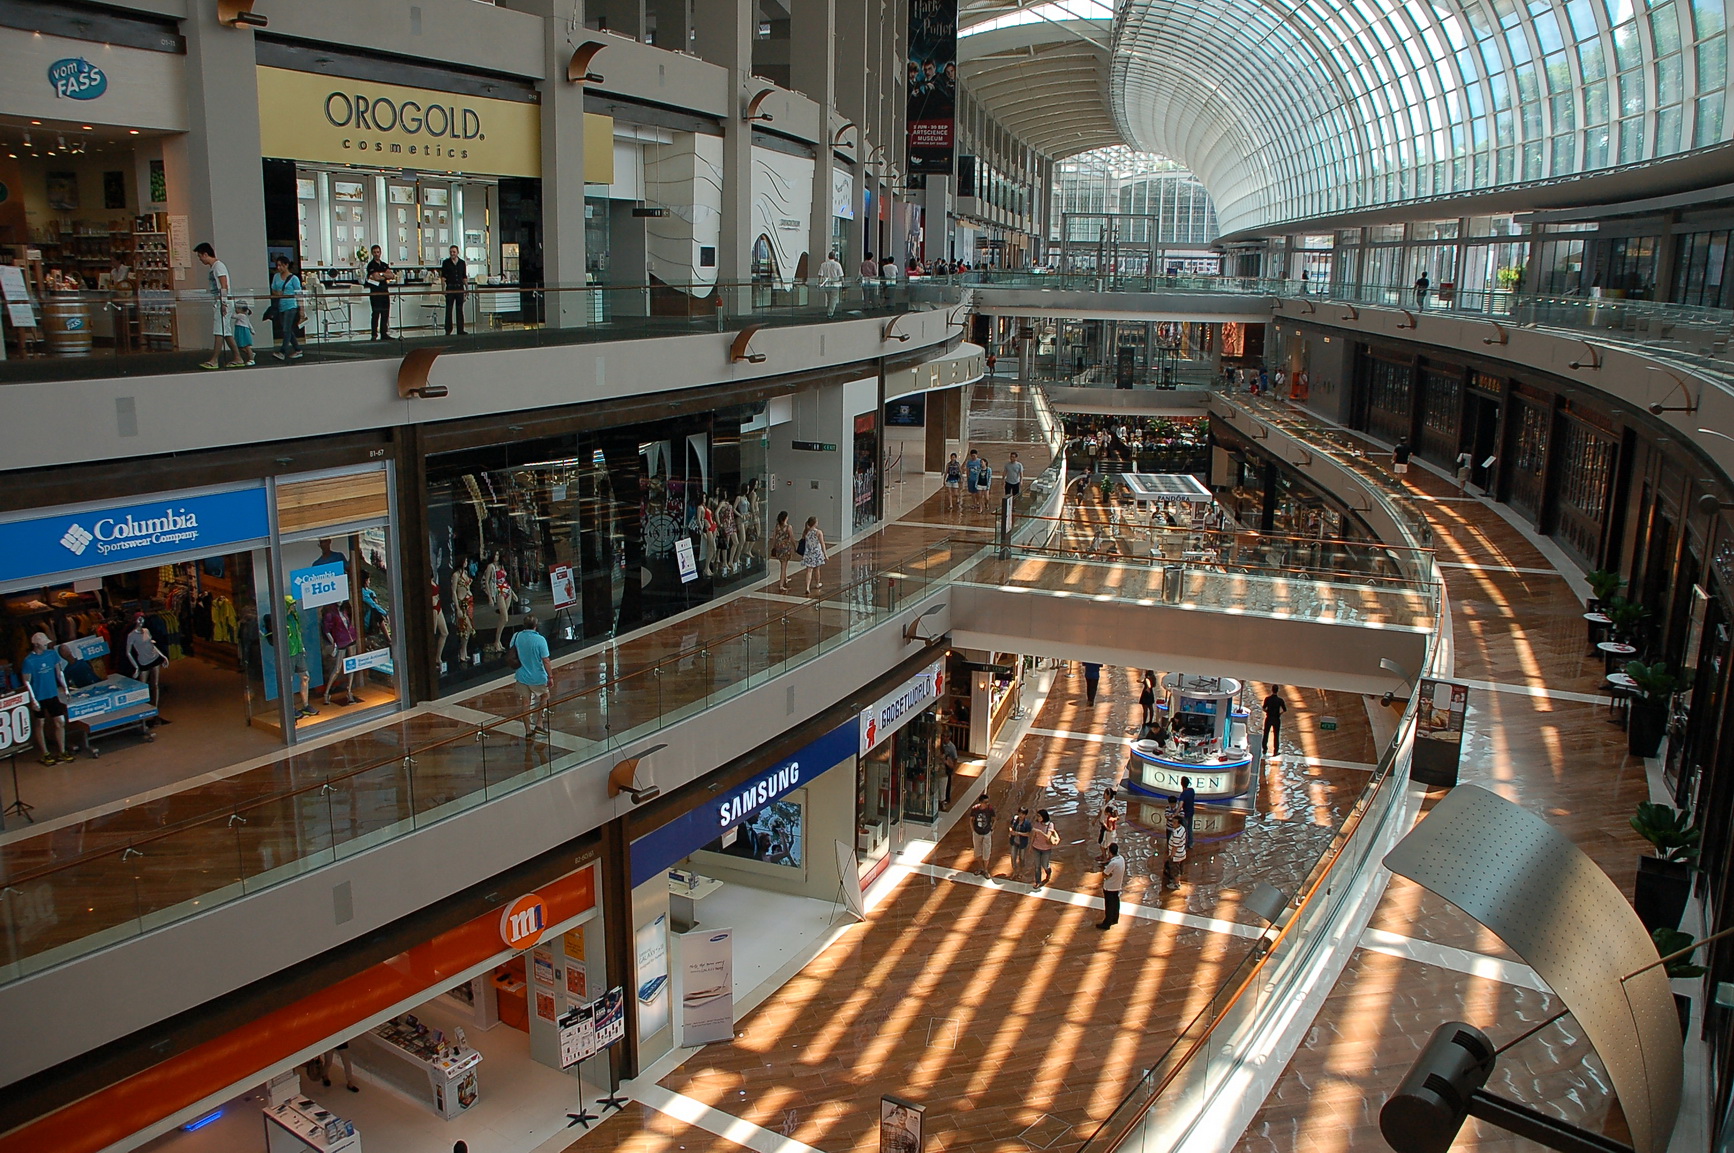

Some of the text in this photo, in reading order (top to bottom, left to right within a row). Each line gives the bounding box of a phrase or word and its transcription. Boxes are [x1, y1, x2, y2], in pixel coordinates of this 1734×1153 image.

[53, 62, 78, 79] vom
[57, 68, 101, 98] FASS
[324, 91, 482, 140] OROGOLD
[342, 138, 469, 159] cosmetics
[94, 508, 199, 541] Columbia
[97, 537, 152, 556] Sportswear
[311, 581, 337, 596] Hot
[720, 761, 799, 828] SAMSUNG
